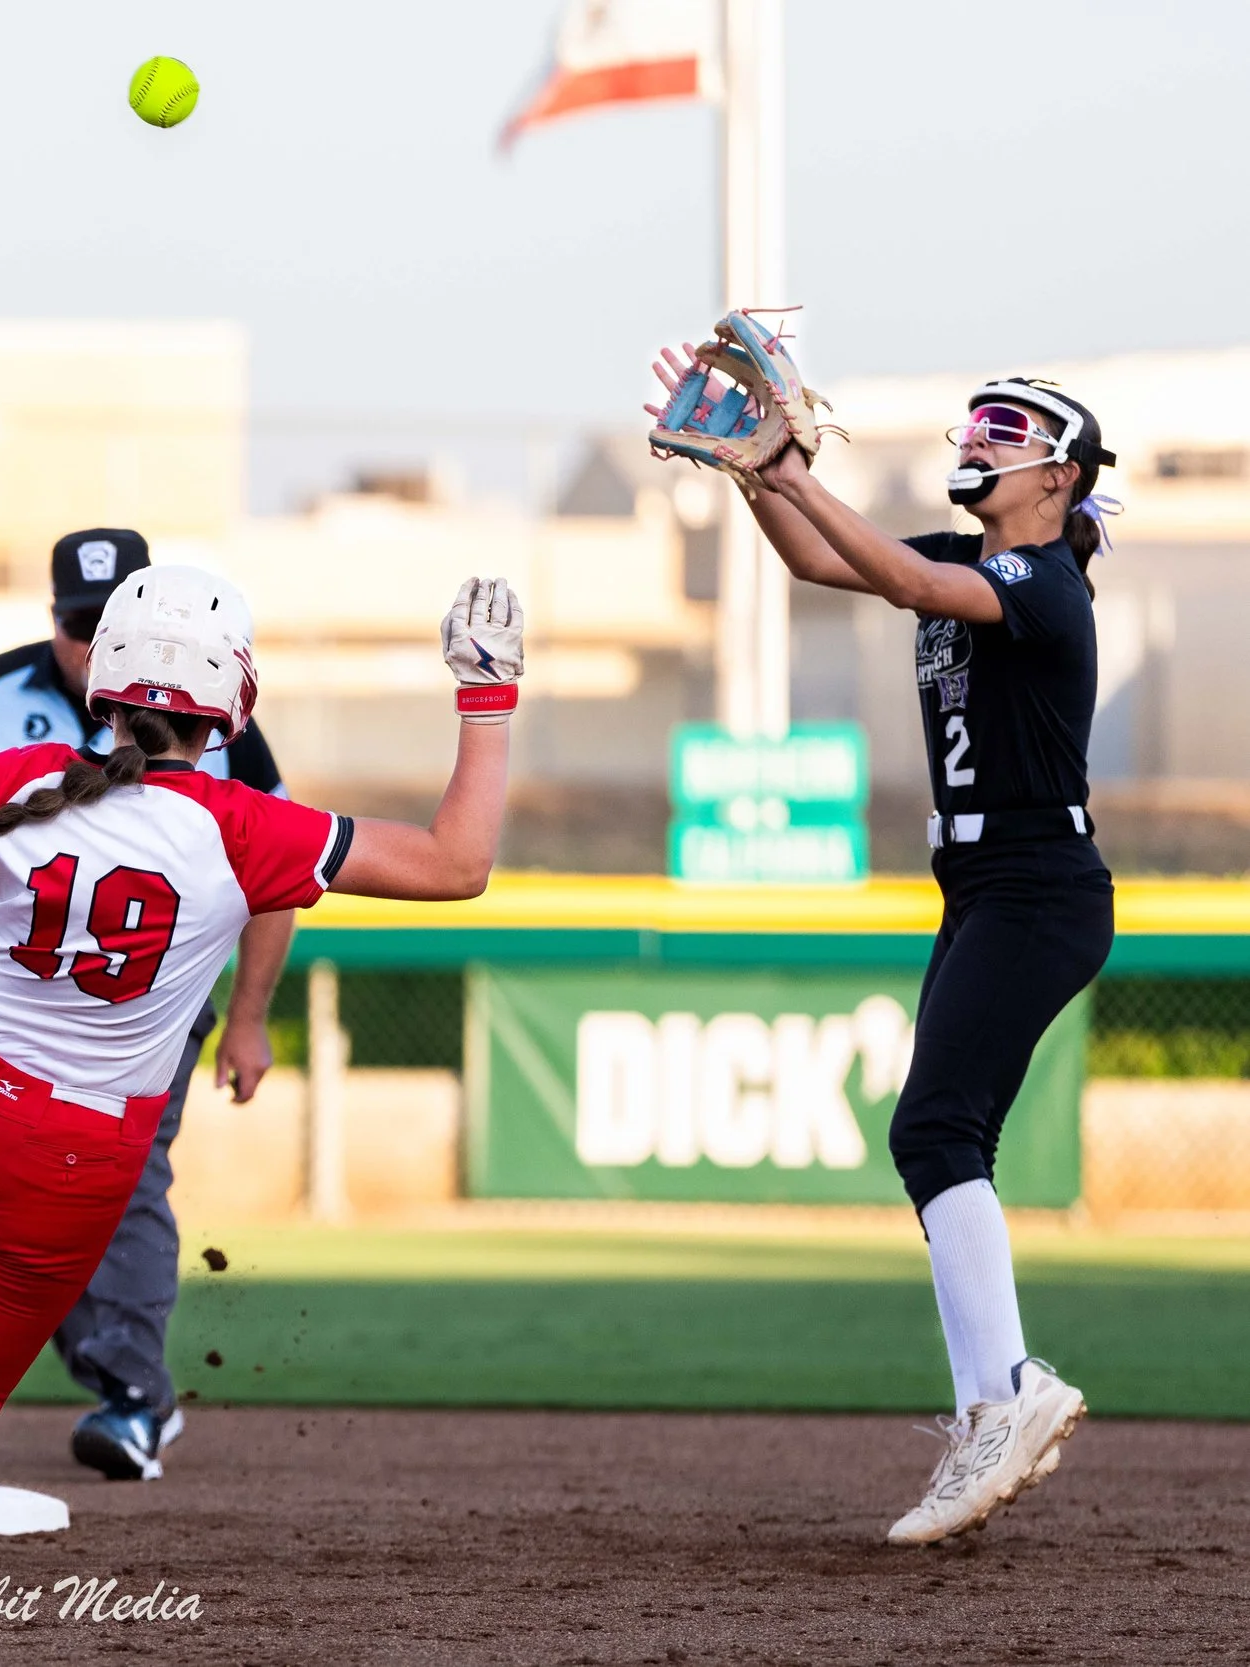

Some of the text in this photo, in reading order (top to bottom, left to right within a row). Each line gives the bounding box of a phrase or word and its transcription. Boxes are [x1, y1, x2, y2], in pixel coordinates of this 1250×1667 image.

[137, 677, 182, 689] RAWLINGS
[944, 715, 975, 787] 2
[9, 852, 180, 1004] 19
[576, 994, 916, 1169] DICK'
